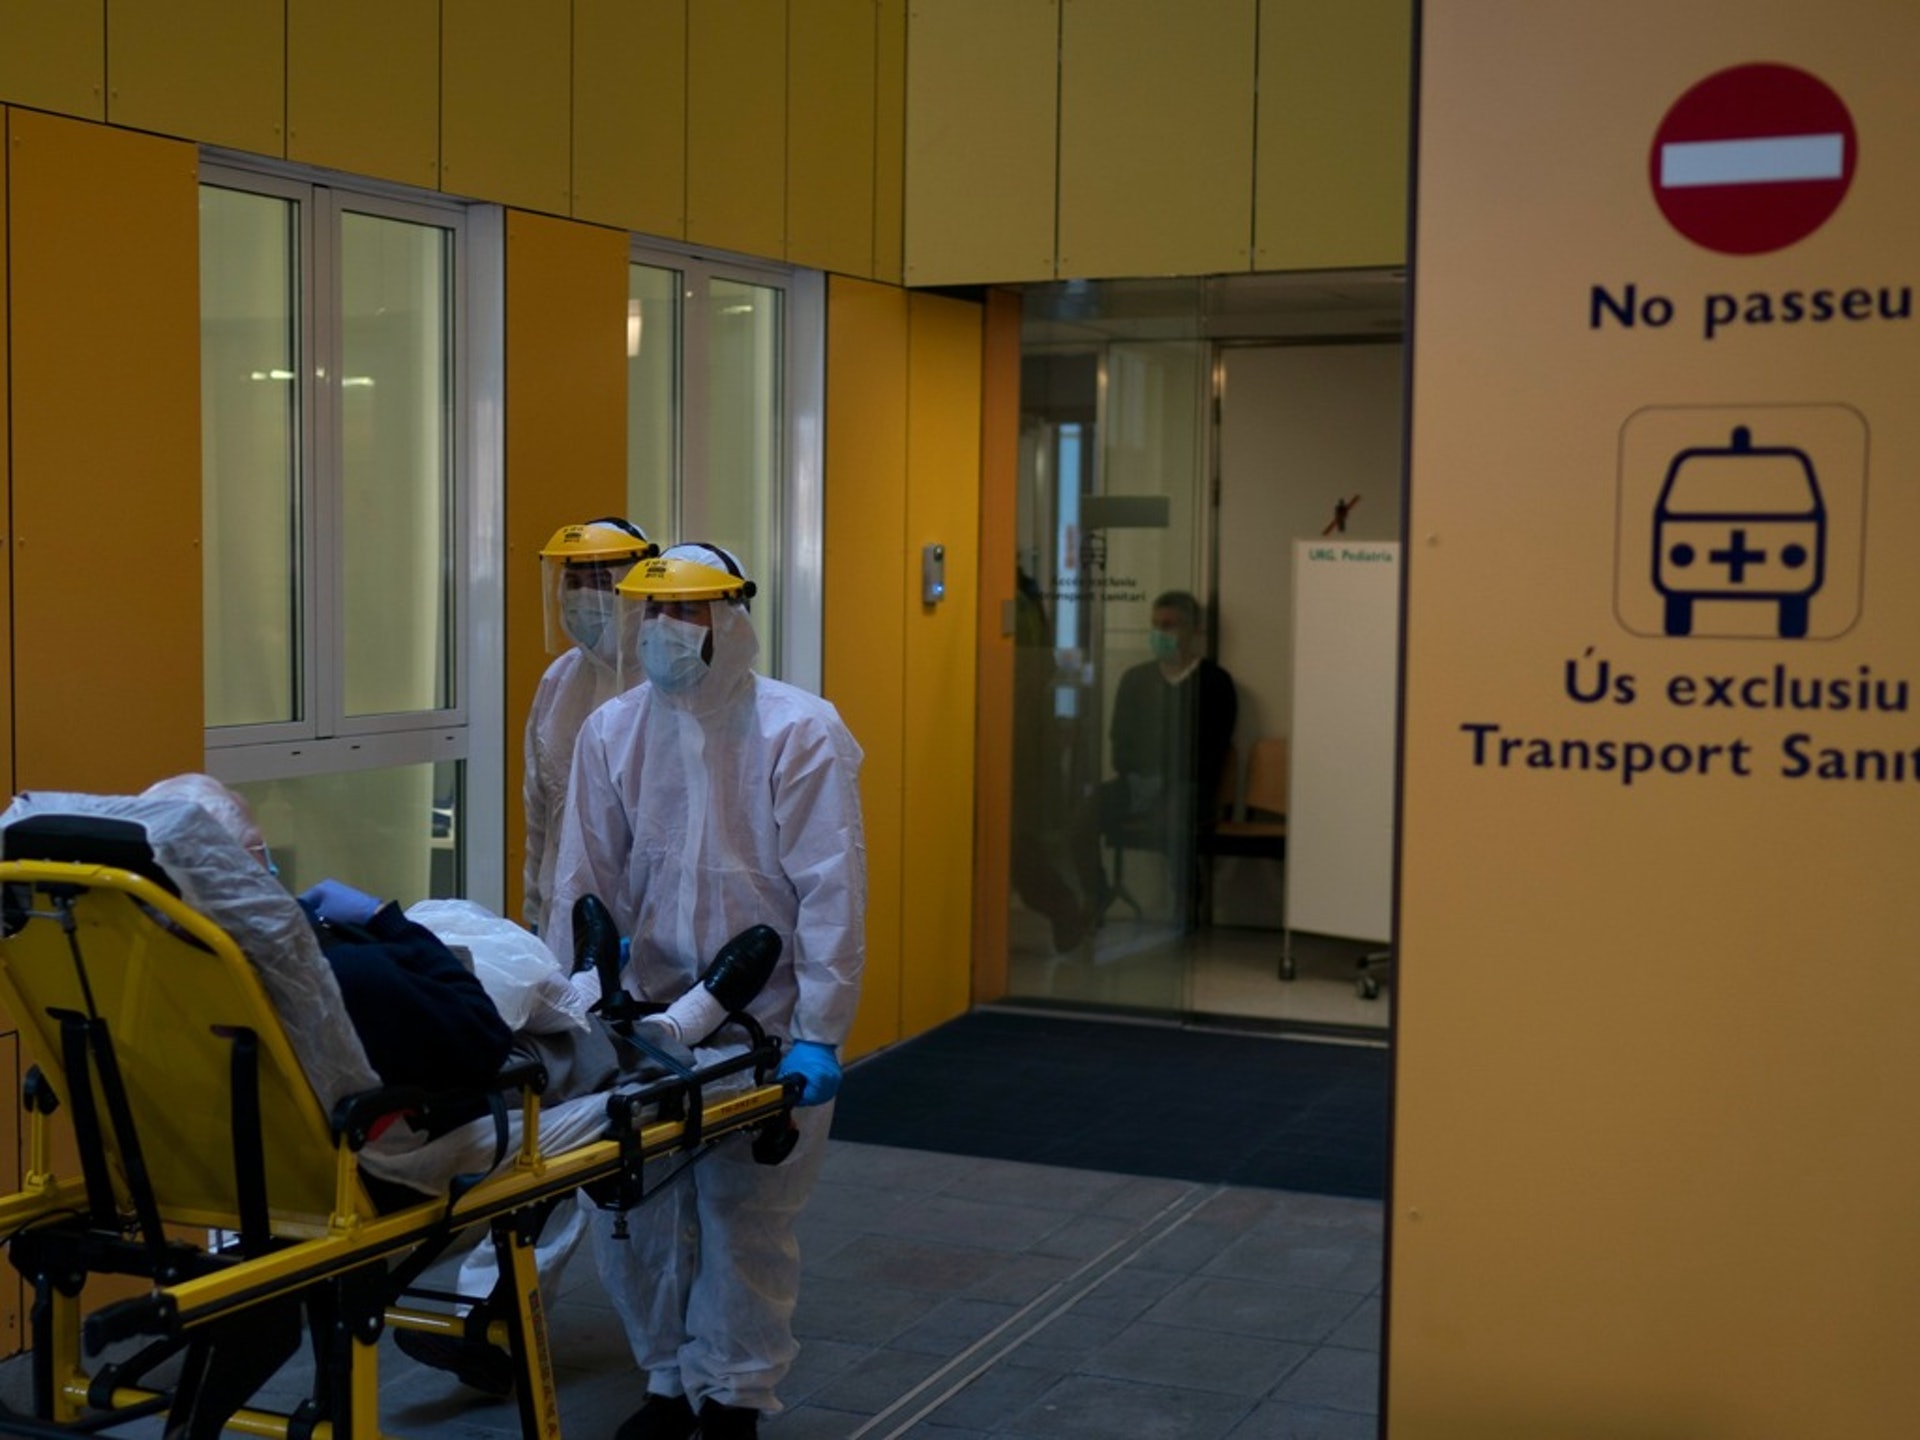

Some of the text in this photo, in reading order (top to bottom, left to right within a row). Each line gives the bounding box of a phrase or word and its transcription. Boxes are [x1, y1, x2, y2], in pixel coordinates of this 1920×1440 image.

[1589, 283, 1913, 340] No passeu
[1564, 646, 1909, 712] Ús exclusiu
[1460, 723, 1752, 786] Transport
